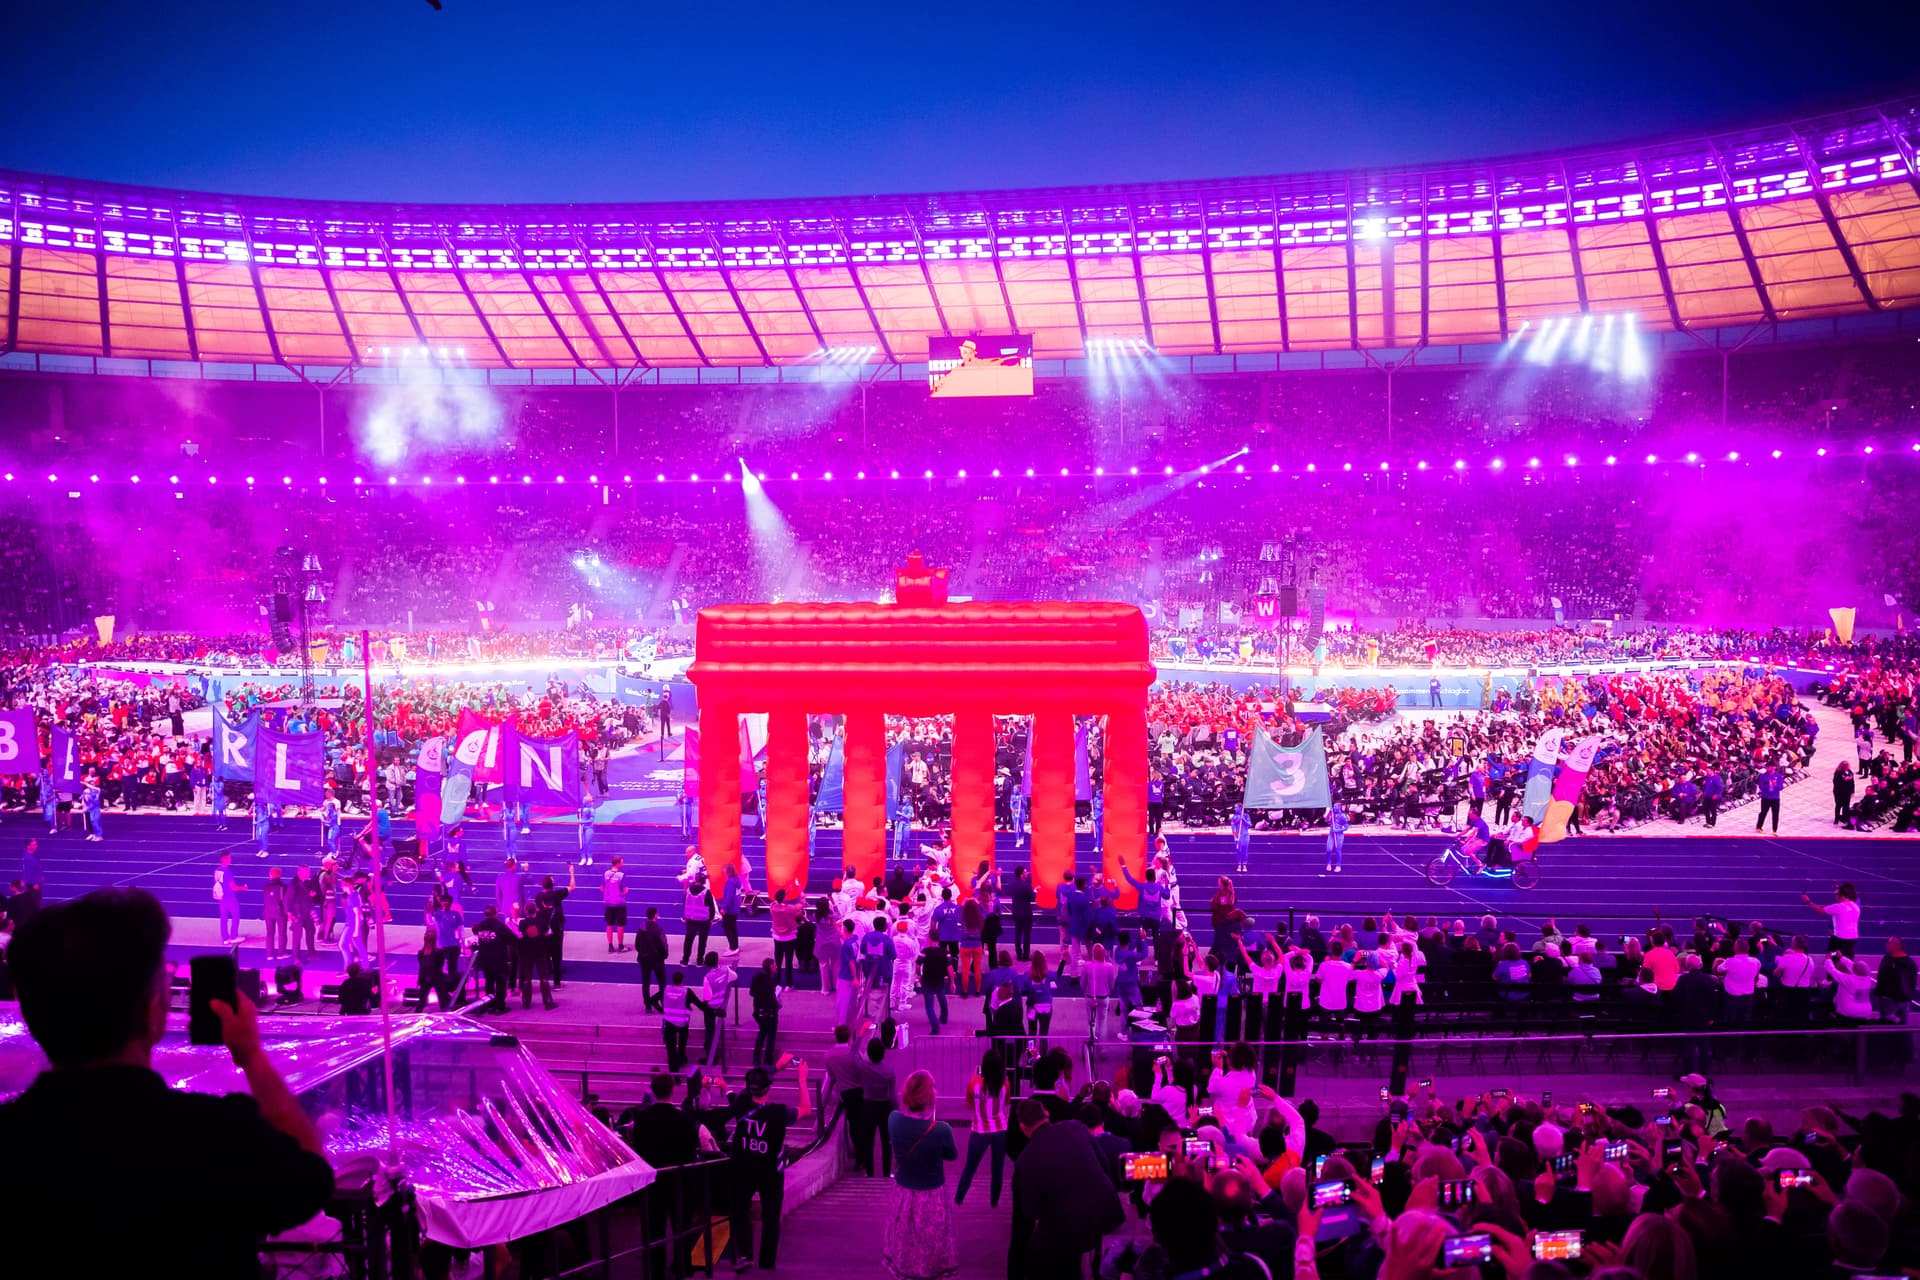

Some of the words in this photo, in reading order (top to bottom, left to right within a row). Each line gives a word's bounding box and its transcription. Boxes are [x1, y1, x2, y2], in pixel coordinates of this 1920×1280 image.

[1258, 600, 1274, 616] W
[0, 720, 19, 760] B
[221, 722, 248, 768] R
[275, 742, 301, 790] L
[520, 742, 563, 791] N
[1269, 752, 1305, 796] 3
[745, 1118, 767, 1137] TV
[742, 1137, 768, 1154] 180
